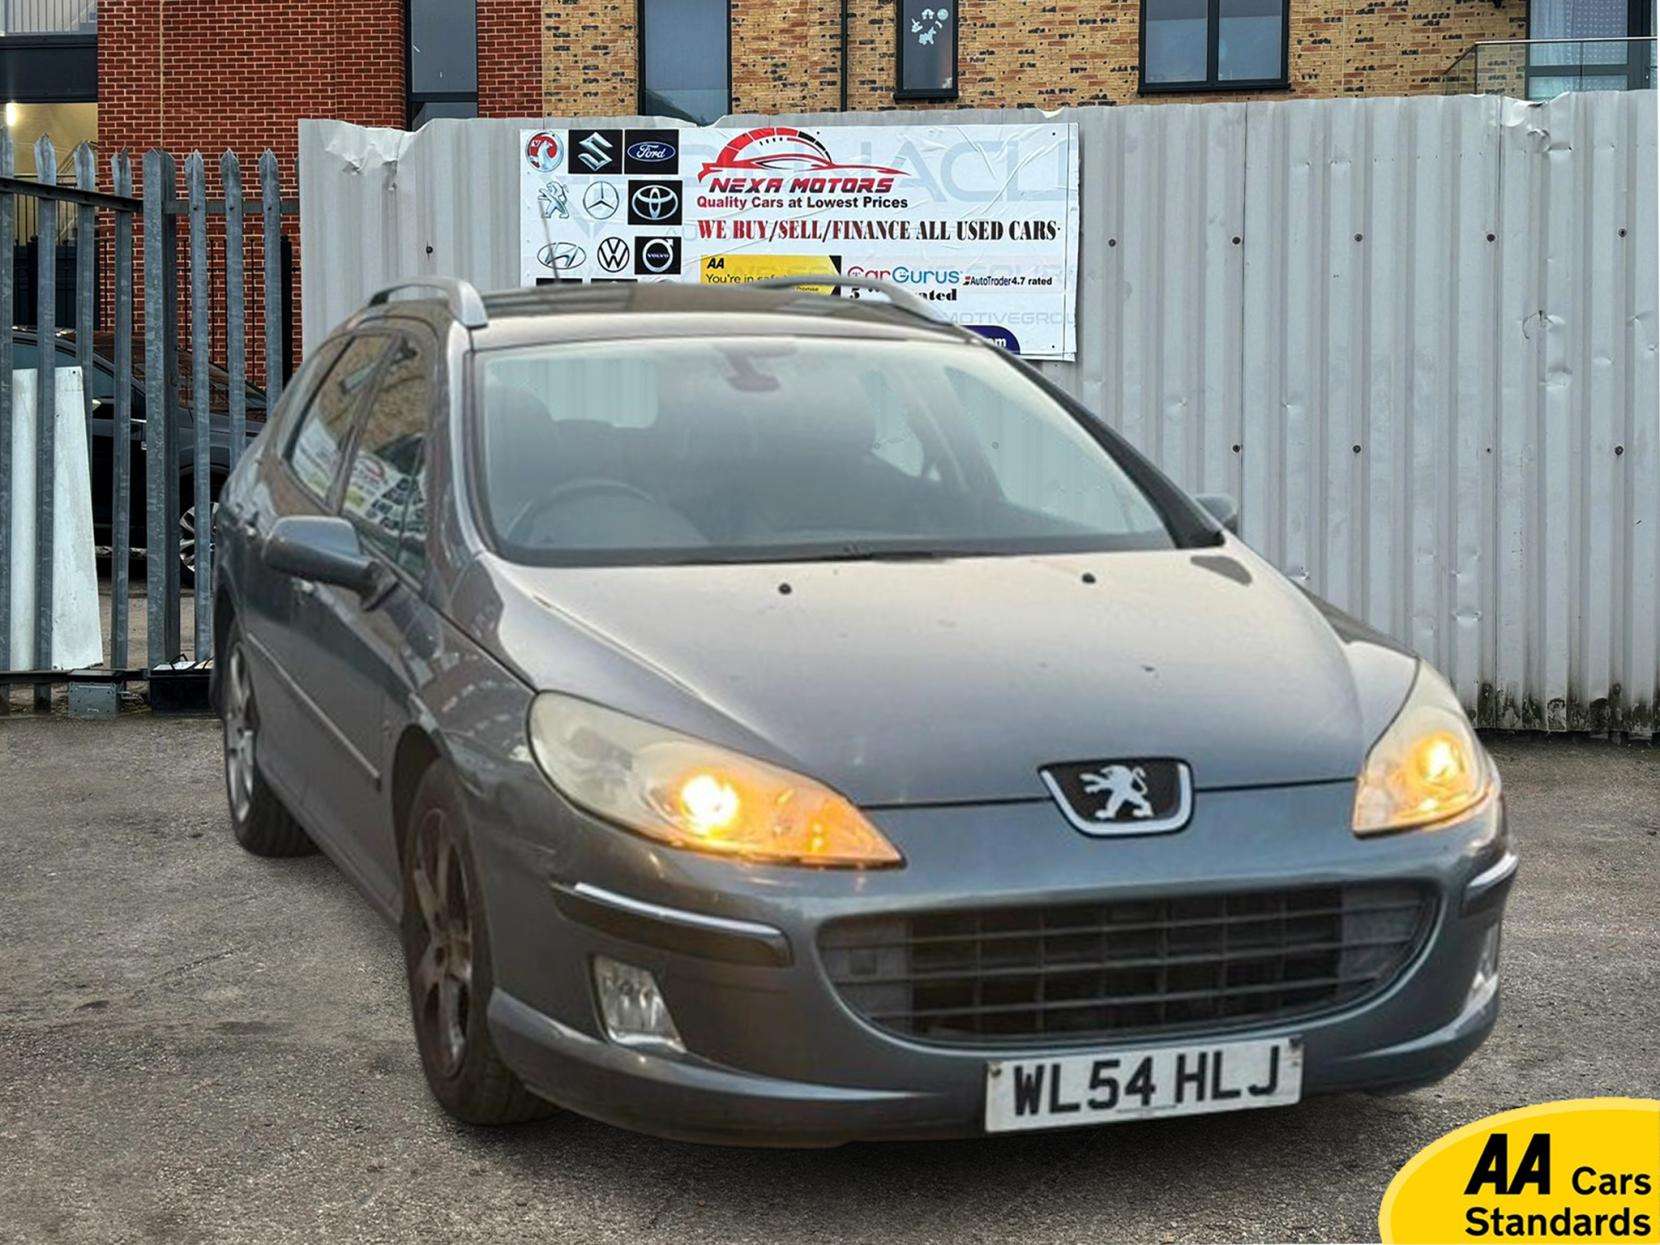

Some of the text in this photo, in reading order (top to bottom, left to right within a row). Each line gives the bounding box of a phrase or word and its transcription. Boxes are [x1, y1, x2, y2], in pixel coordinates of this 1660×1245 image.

[636, 144, 666, 159] Ford
[709, 178, 894, 194] NEXA MOTORS
[697, 196, 908, 211] Quality Cars at Lowest Prices
[697, 220, 727, 240] WE
[733, 219, 911, 243] BUY/SELL/FINANCE
[916, 220, 951, 240] ALL
[957, 220, 1004, 240] USED
[1008, 220, 1057, 240] CARS
[706, 257, 725, 269] AA
[706, 273, 741, 284] You're
[744, 274, 754, 283] in
[847, 266, 960, 284] CarGurus
[1028, 277, 1053, 286] rated
[915, 288, 957, 301] ated
[1014, 1045, 1280, 1117] WL54 HLJ
